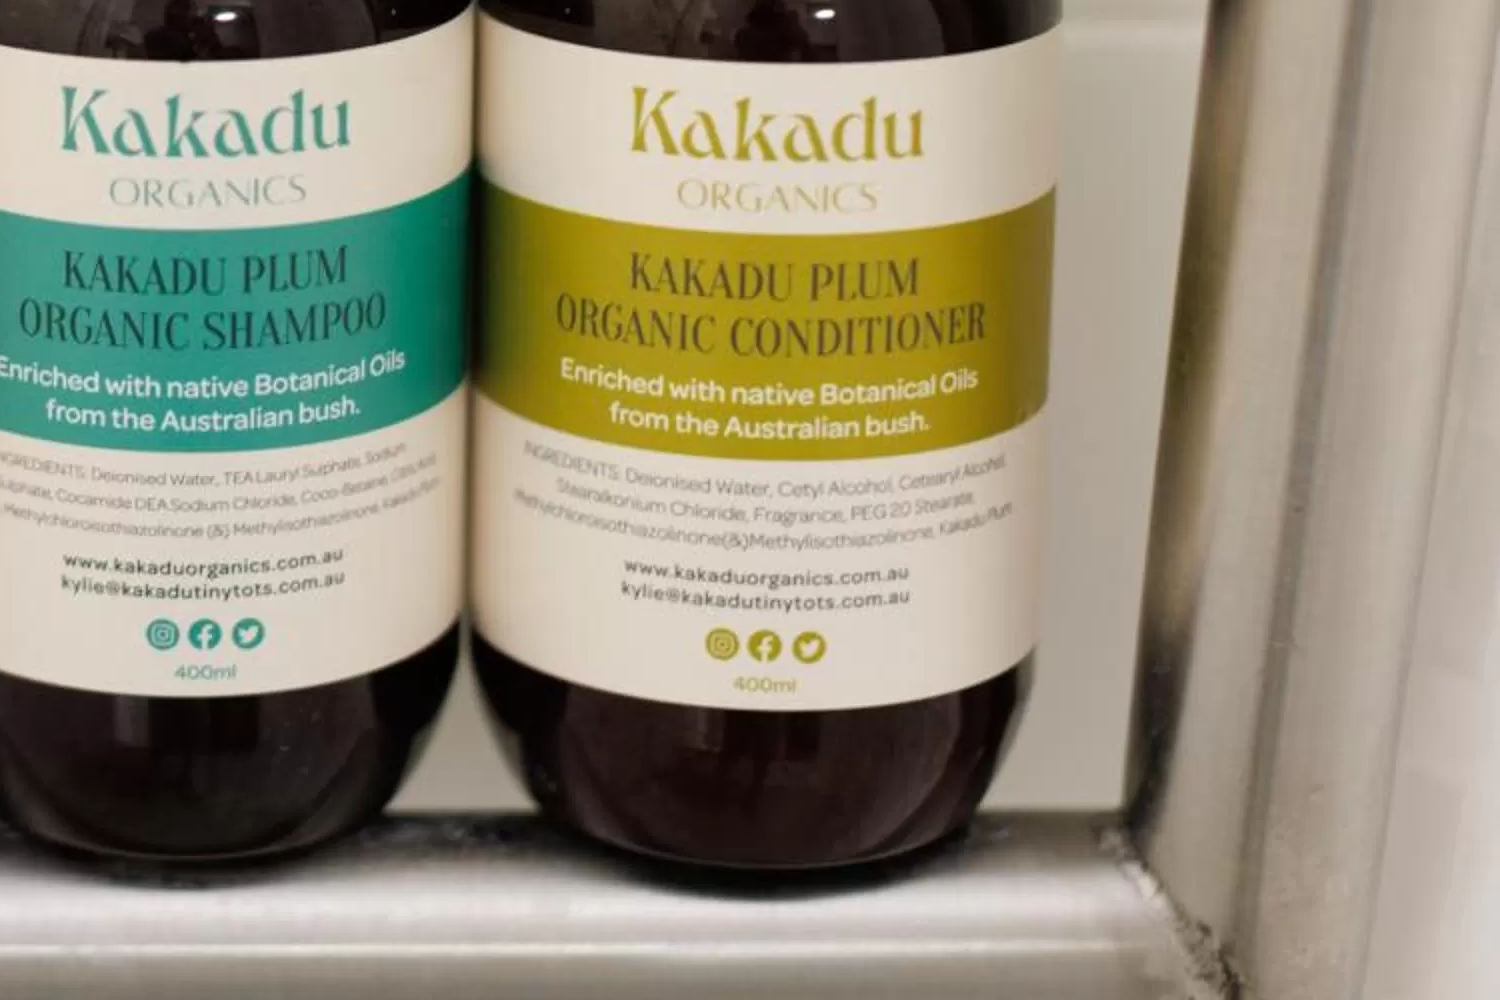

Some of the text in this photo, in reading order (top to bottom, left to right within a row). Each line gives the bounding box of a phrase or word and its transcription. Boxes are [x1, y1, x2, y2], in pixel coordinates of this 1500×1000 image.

[61, 86, 351, 158] Kakadu
[630, 86, 925, 163] Kakadu
[109, 174, 307, 208] ORGANICS
[676, 178, 879, 215] ORGANICS
[63, 244, 349, 295] KAKADU PLUM
[629, 251, 920, 302] KAKADU PLUM
[19, 291, 387, 351] ORGANIC SHAMPOO
[556, 292, 986, 358] ORGANIC CONDITIONER
[105, 369, 162, 398] with
[167, 372, 249, 400] native
[255, 359, 366, 395] Botanical
[369, 349, 406, 375] Oils
[561, 358, 979, 406] Enriched with native Botanical Oils
[45, 395, 361, 434] from the Australian bush.
[610, 402, 929, 441] from the Australian bush.
[63, 548, 343, 579] www.kakaduorganics.com.au
[623, 557, 909, 591] www.kakaduorganics.com.au
[61, 571, 346, 601] kylie@kakadutinytots.com.au
[621, 580, 910, 615] kylie@kakadutinytots.com.au
[174, 664, 238, 681] 400ml
[733, 675, 798, 693] 400ml
